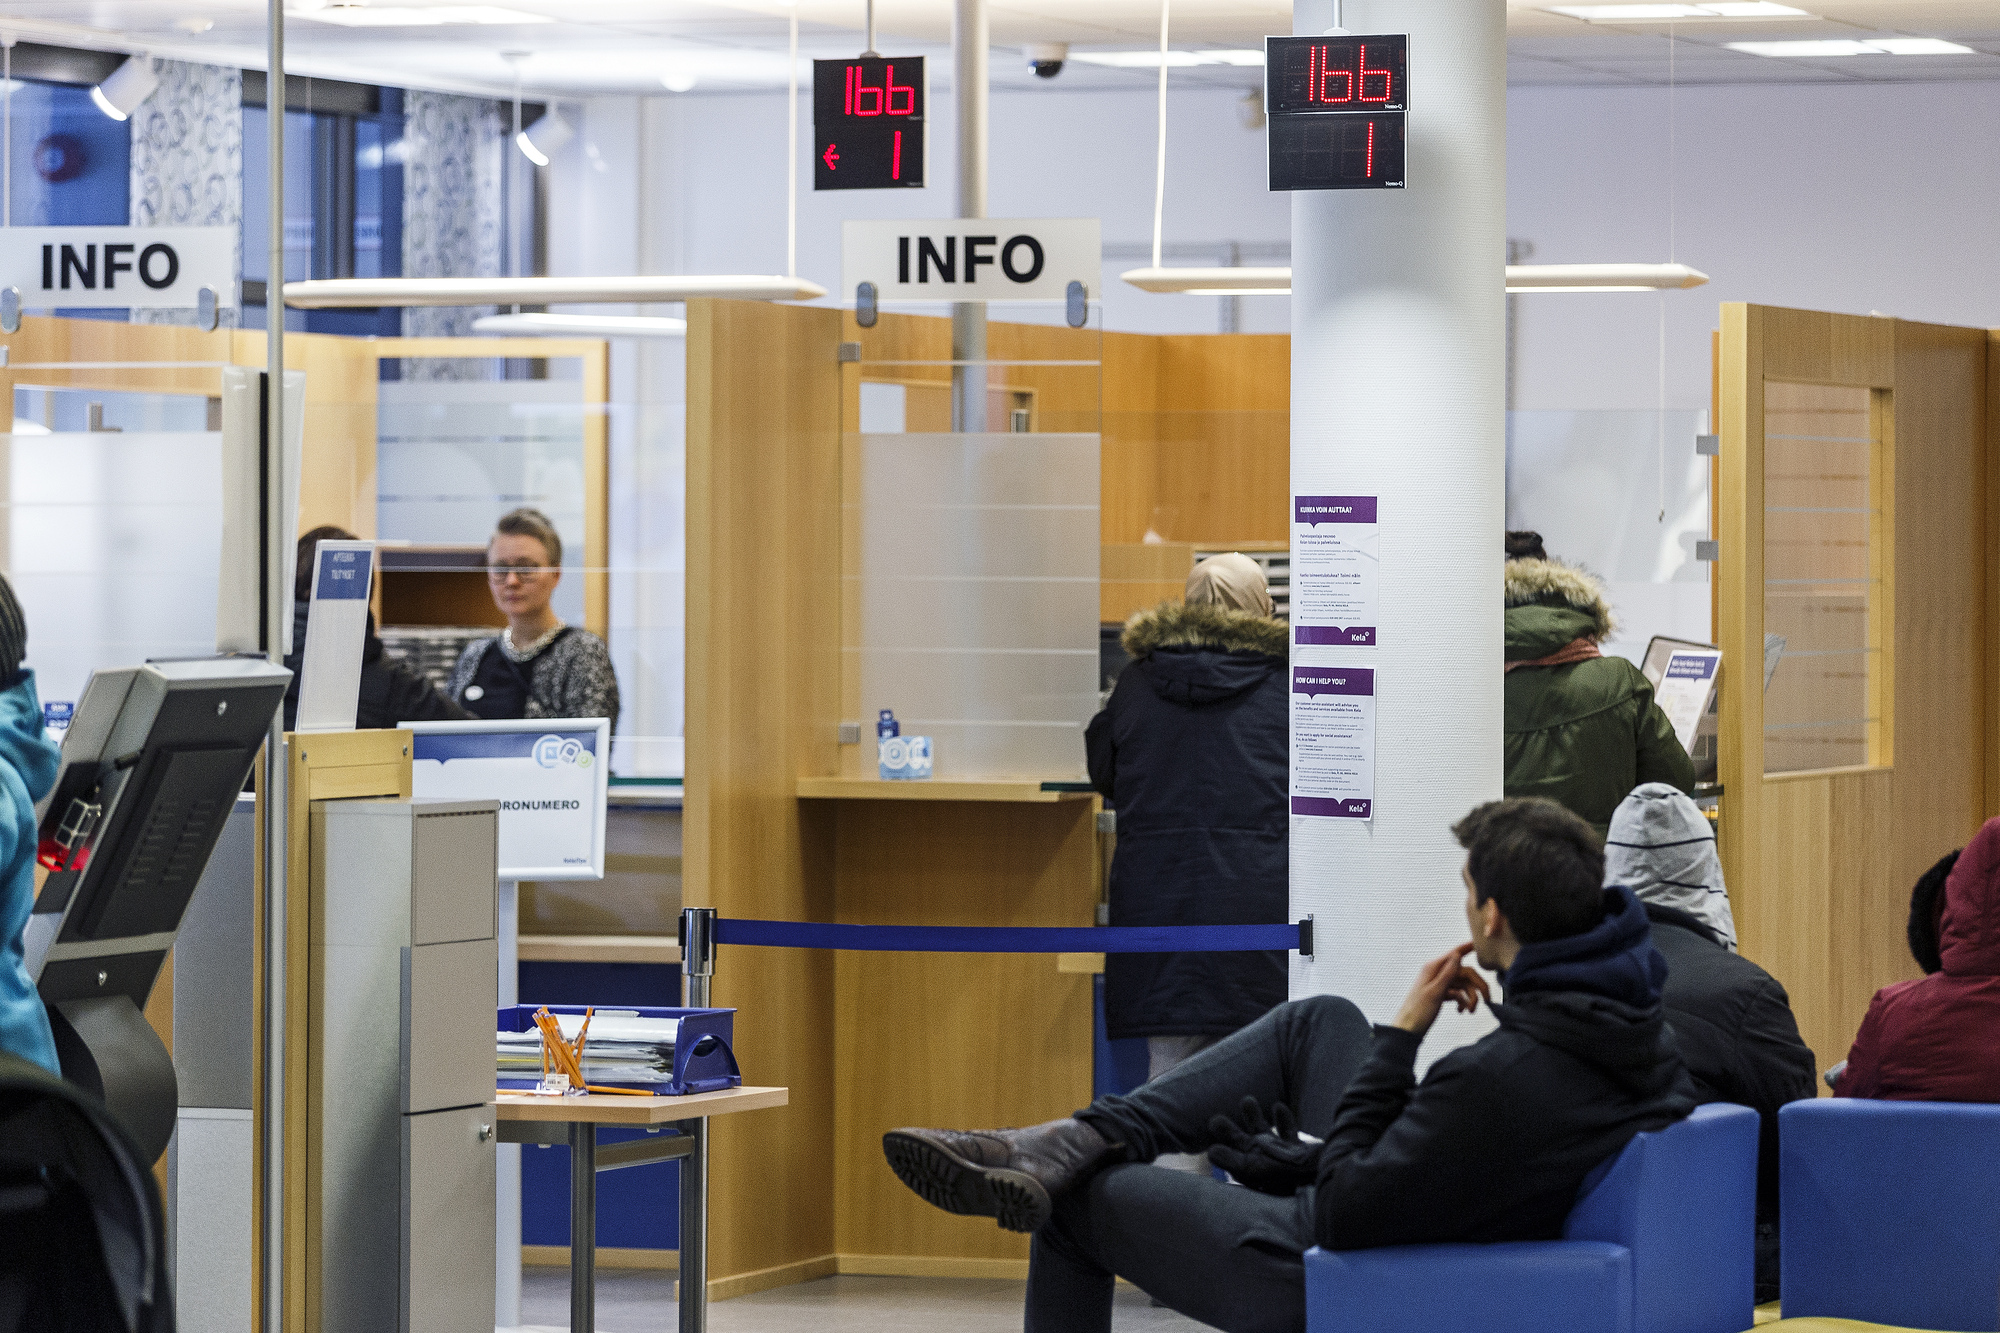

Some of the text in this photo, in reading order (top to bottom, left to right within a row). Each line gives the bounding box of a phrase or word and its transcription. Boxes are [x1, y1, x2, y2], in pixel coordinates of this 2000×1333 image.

[845, 65, 914, 116] 166
[1309, 45, 1391, 102] 166
[892, 131, 901, 180] 1
[1366, 122, 1373, 178] 1
[42, 242, 179, 290] INFO
[898, 235, 1045, 284] INFO
[498, 800, 580, 810] RONUMERO
[1349, 804, 1363, 812] Kela
